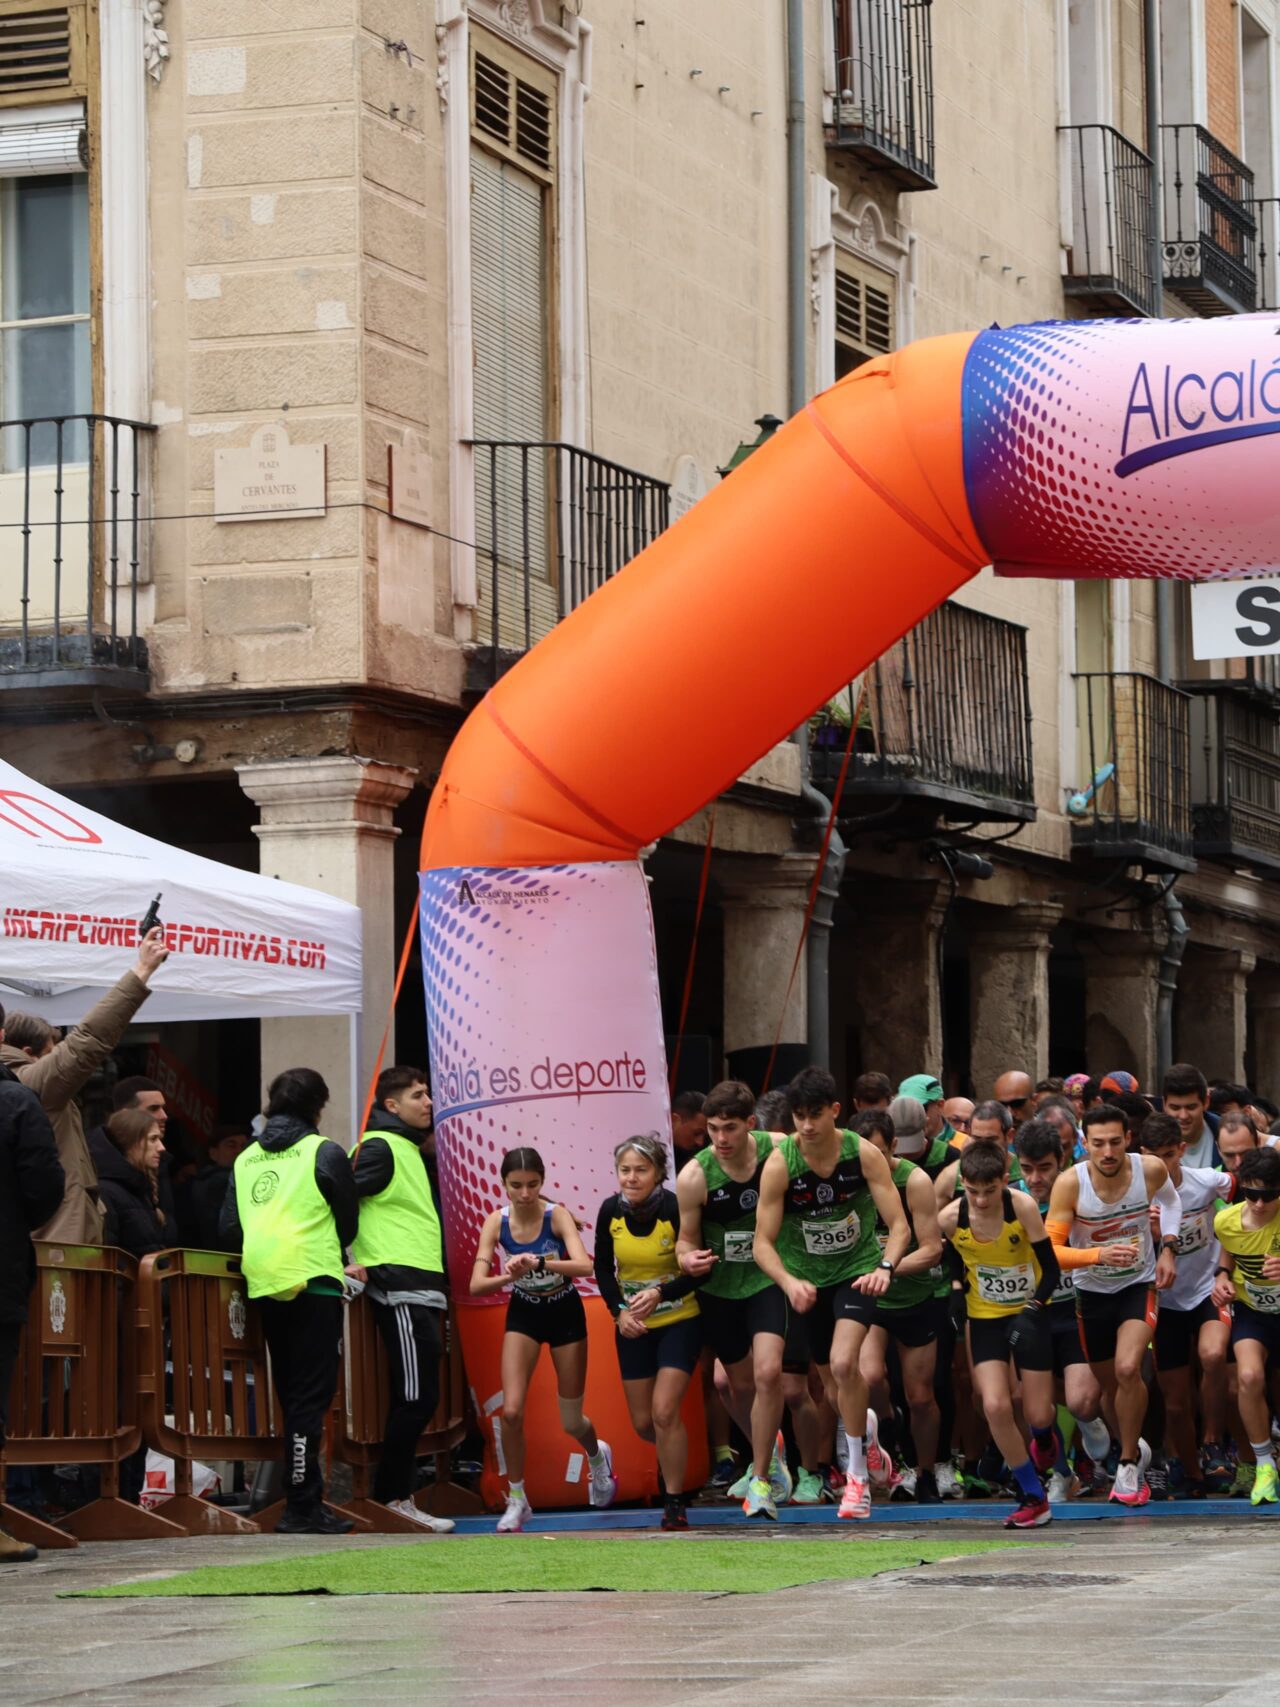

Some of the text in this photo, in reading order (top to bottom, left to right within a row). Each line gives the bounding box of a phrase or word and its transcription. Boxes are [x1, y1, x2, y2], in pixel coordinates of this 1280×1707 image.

[242, 484, 297, 497] CERVANTES
[514, 889, 549, 898] HENARES
[489, 1066, 521, 1095] es
[530, 1051, 646, 1106] deporte
[812, 1225, 854, 1245] 2965
[984, 1277, 1029, 1293] 2392
